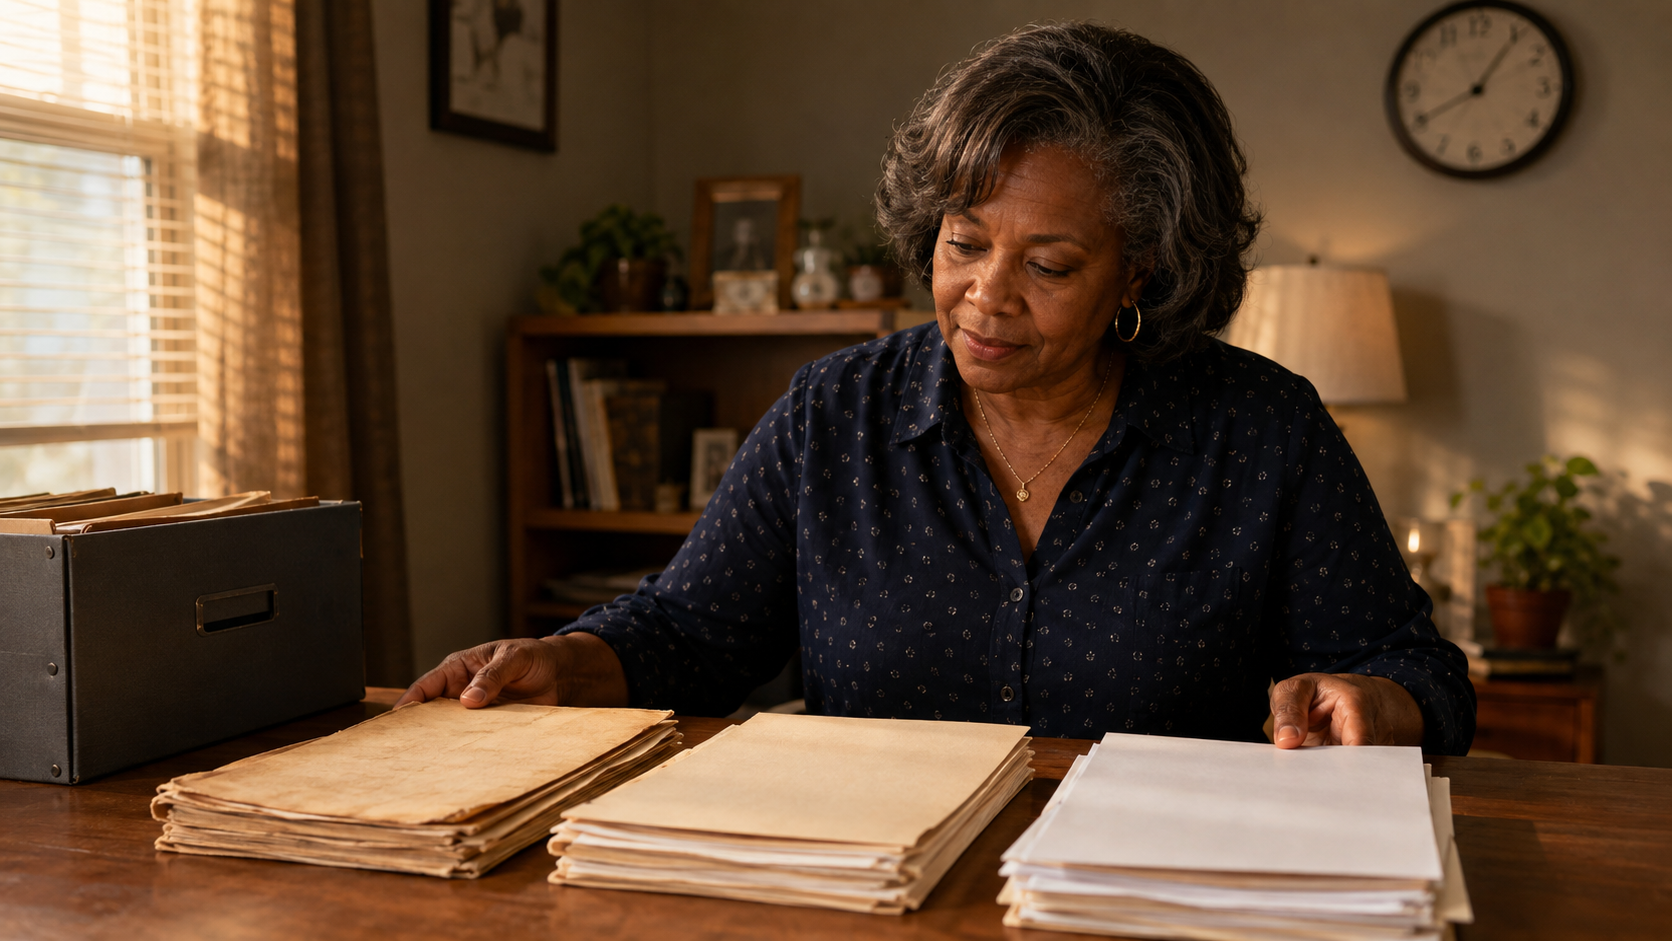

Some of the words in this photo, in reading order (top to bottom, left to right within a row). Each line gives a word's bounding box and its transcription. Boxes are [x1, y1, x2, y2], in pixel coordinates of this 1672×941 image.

[1440, 23, 1457, 48] 11
[1468, 13, 1492, 39] 12
[1403, 79, 1421, 103] 9
[1534, 75, 1551, 99] 3
[1466, 140, 1483, 163] 6
